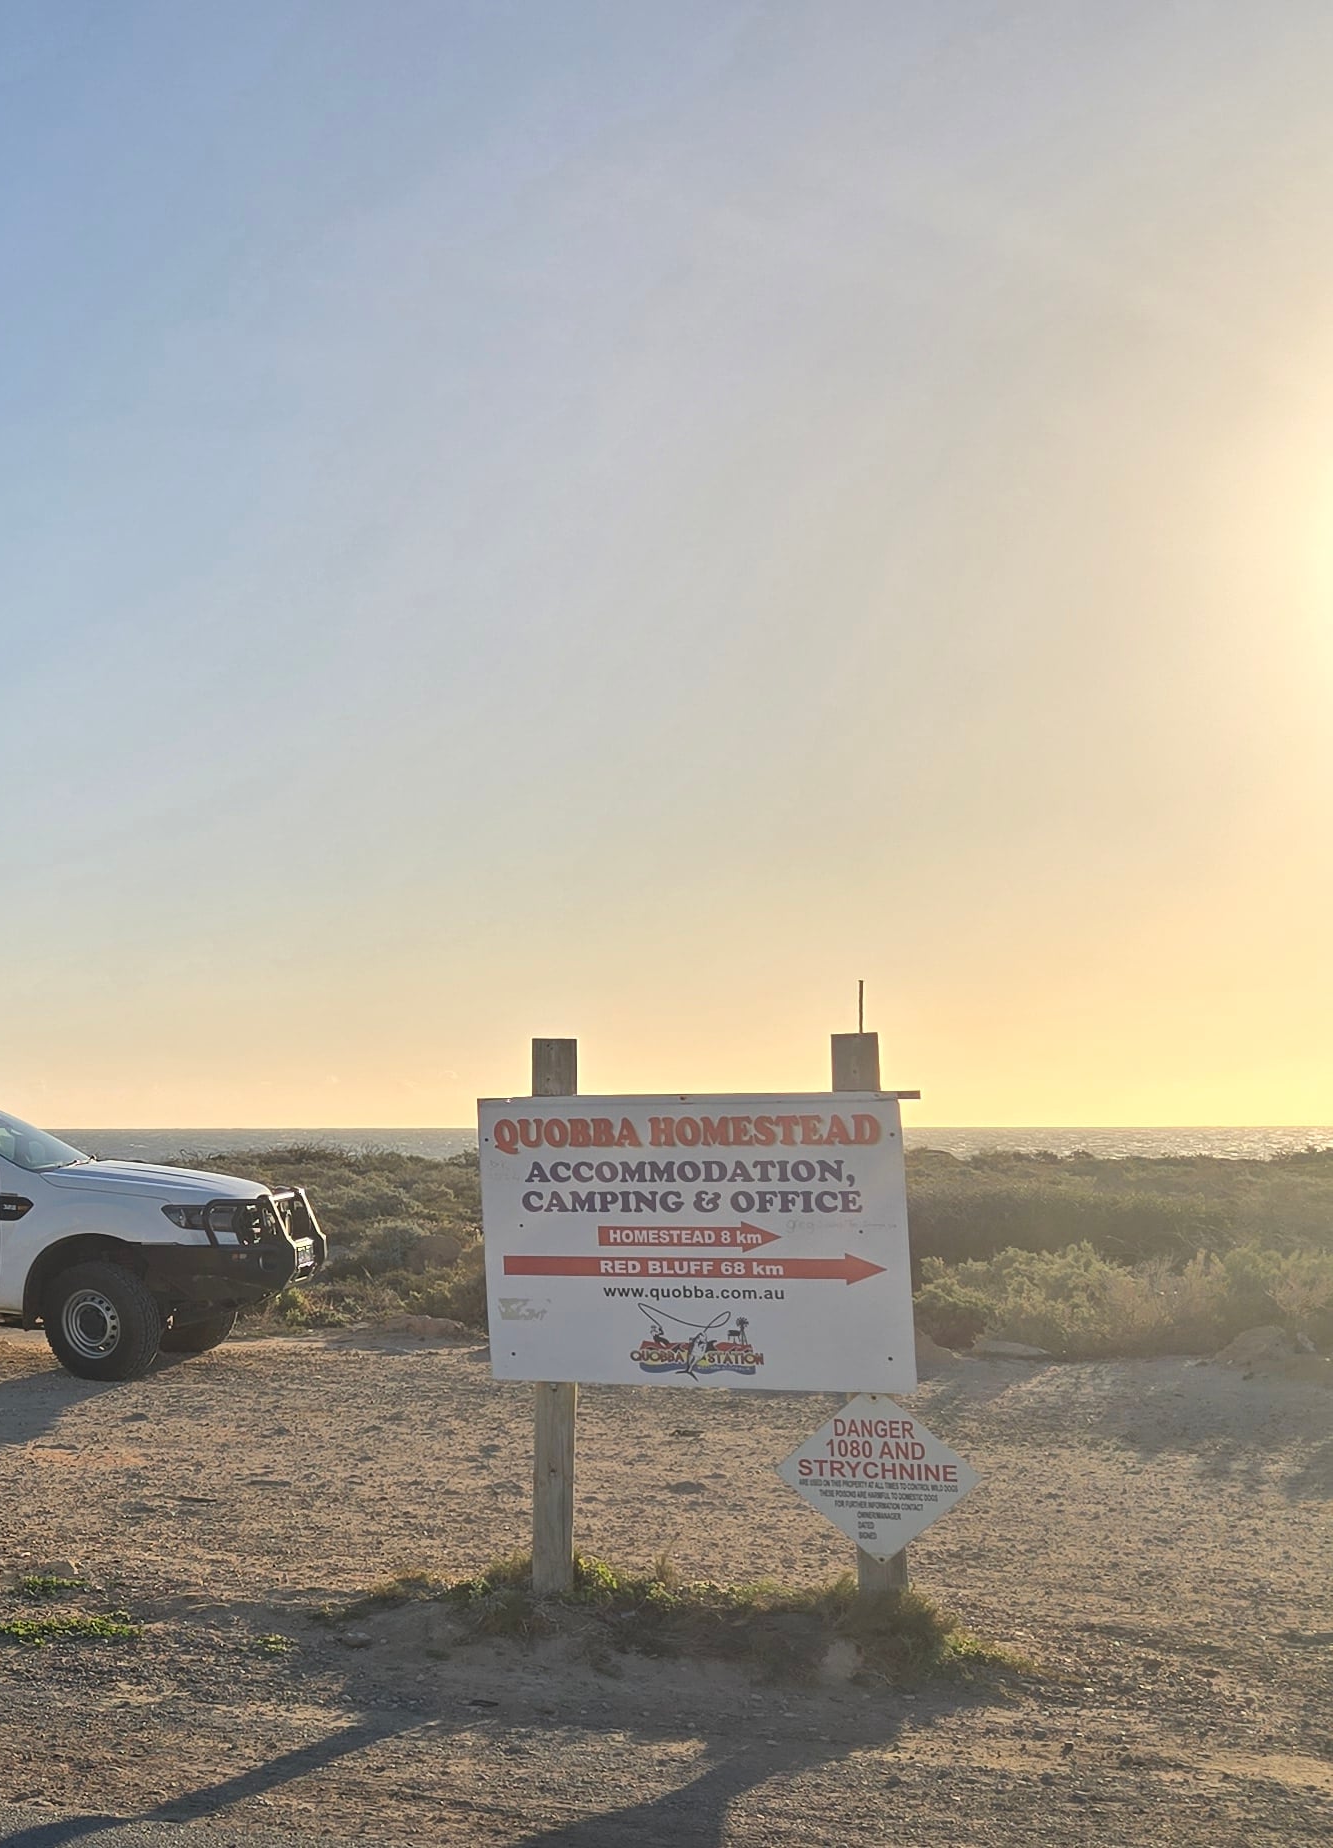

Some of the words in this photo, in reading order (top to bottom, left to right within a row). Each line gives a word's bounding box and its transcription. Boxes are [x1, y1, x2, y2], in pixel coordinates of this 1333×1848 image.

[493, 1117, 642, 1154] QUOBBA
[648, 1114, 881, 1147] HOMESTEAD
[525, 1159, 855, 1187] ACCOMMODATION,
[521, 1190, 684, 1213] CAMPING
[693, 1190, 719, 1213] &
[730, 1190, 863, 1213] OFFICE
[609, 1230, 715, 1244] HOMESTEAD
[721, 1230, 731, 1244] 8
[736, 1231, 762, 1244] km
[600, 1260, 641, 1274] RED
[648, 1260, 714, 1275] BLUFF
[720, 1262, 746, 1275] 68
[753, 1262, 784, 1276] km
[603, 1286, 785, 1301] www.quobba.com.au
[630, 1351, 685, 1363] QUOBBA
[707, 1352, 764, 1365] STATION
[833, 1418, 915, 1439] DANGER
[826, 1439, 873, 1458] 1080
[879, 1441, 925, 1460] AND
[798, 1459, 958, 1483] STRYCHNINE
[831, 1480, 841, 1488] THIS
[843, 1480, 867, 1488] PROPERTY
[906, 1483, 930, 1491] CONTROL
[820, 1489, 834, 1497] THESE
[898, 1493, 923, 1501] DOMESTIC
[924, 1494, 938, 1502] DOGS
[845, 1500, 867, 1508] FURTHER
[868, 1501, 900, 1510] INFORMATION
[901, 1502, 923, 1511] CONTACT
[858, 1521, 874, 1529] DATED
